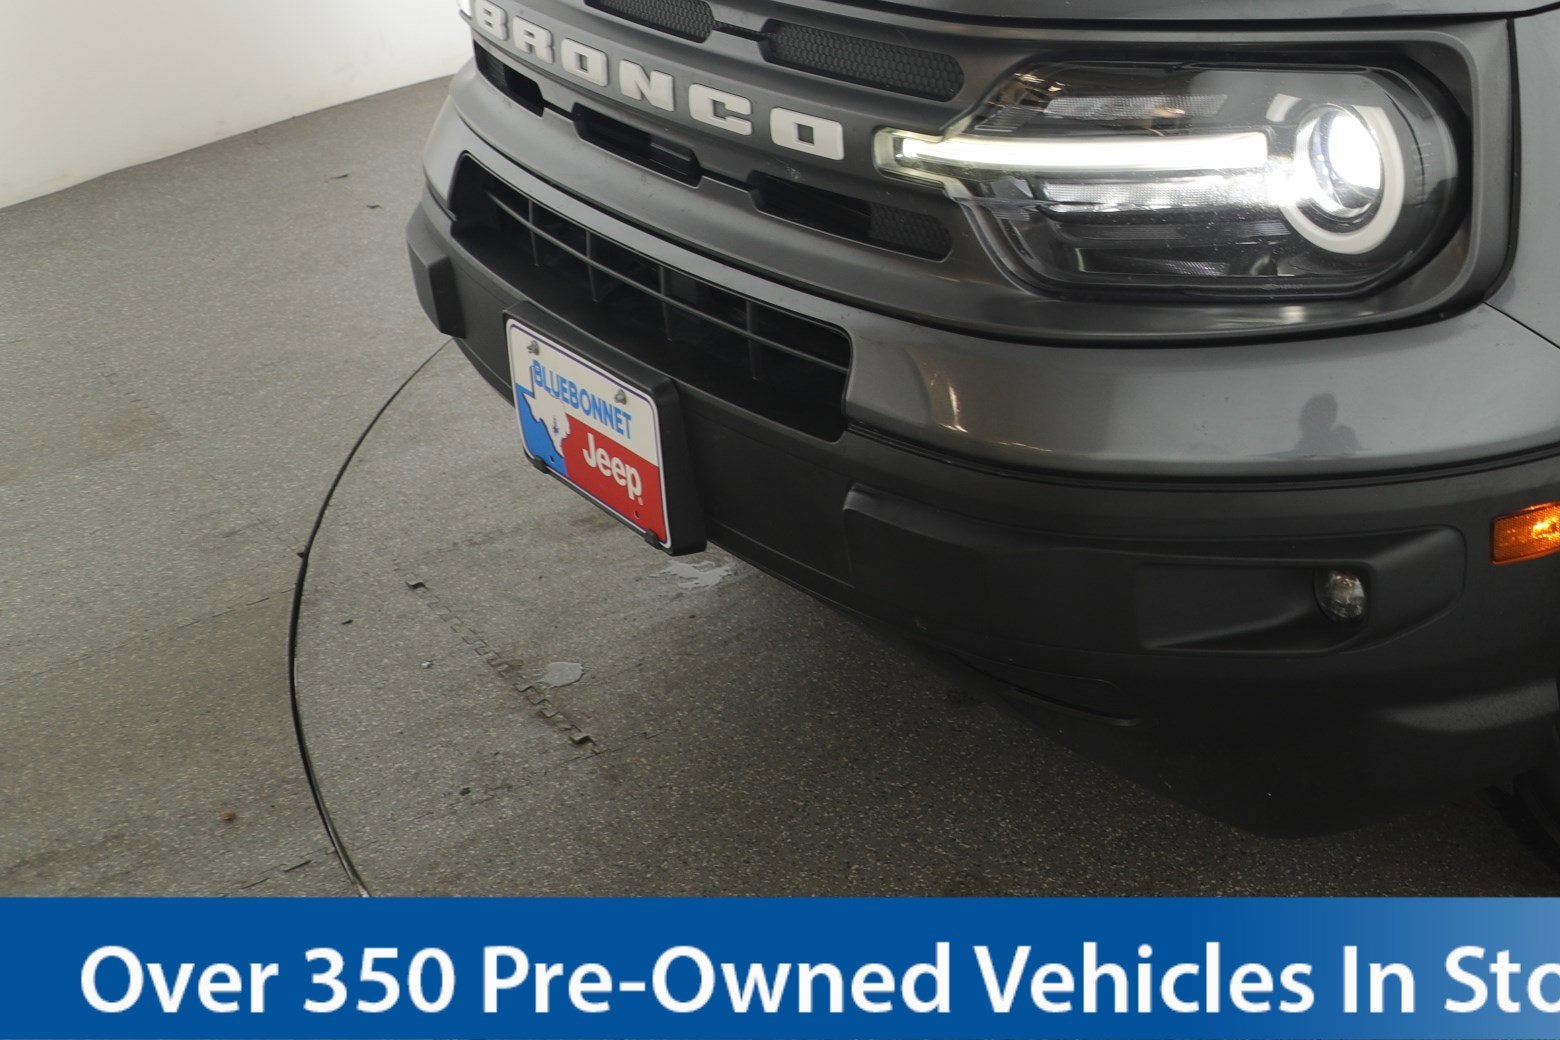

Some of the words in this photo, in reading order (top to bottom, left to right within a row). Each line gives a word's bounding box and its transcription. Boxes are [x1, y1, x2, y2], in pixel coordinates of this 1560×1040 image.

[476, 2, 845, 161] BRONCO
[531, 359, 633, 440] BLUEBONNET
[582, 432, 643, 500] Jeep
